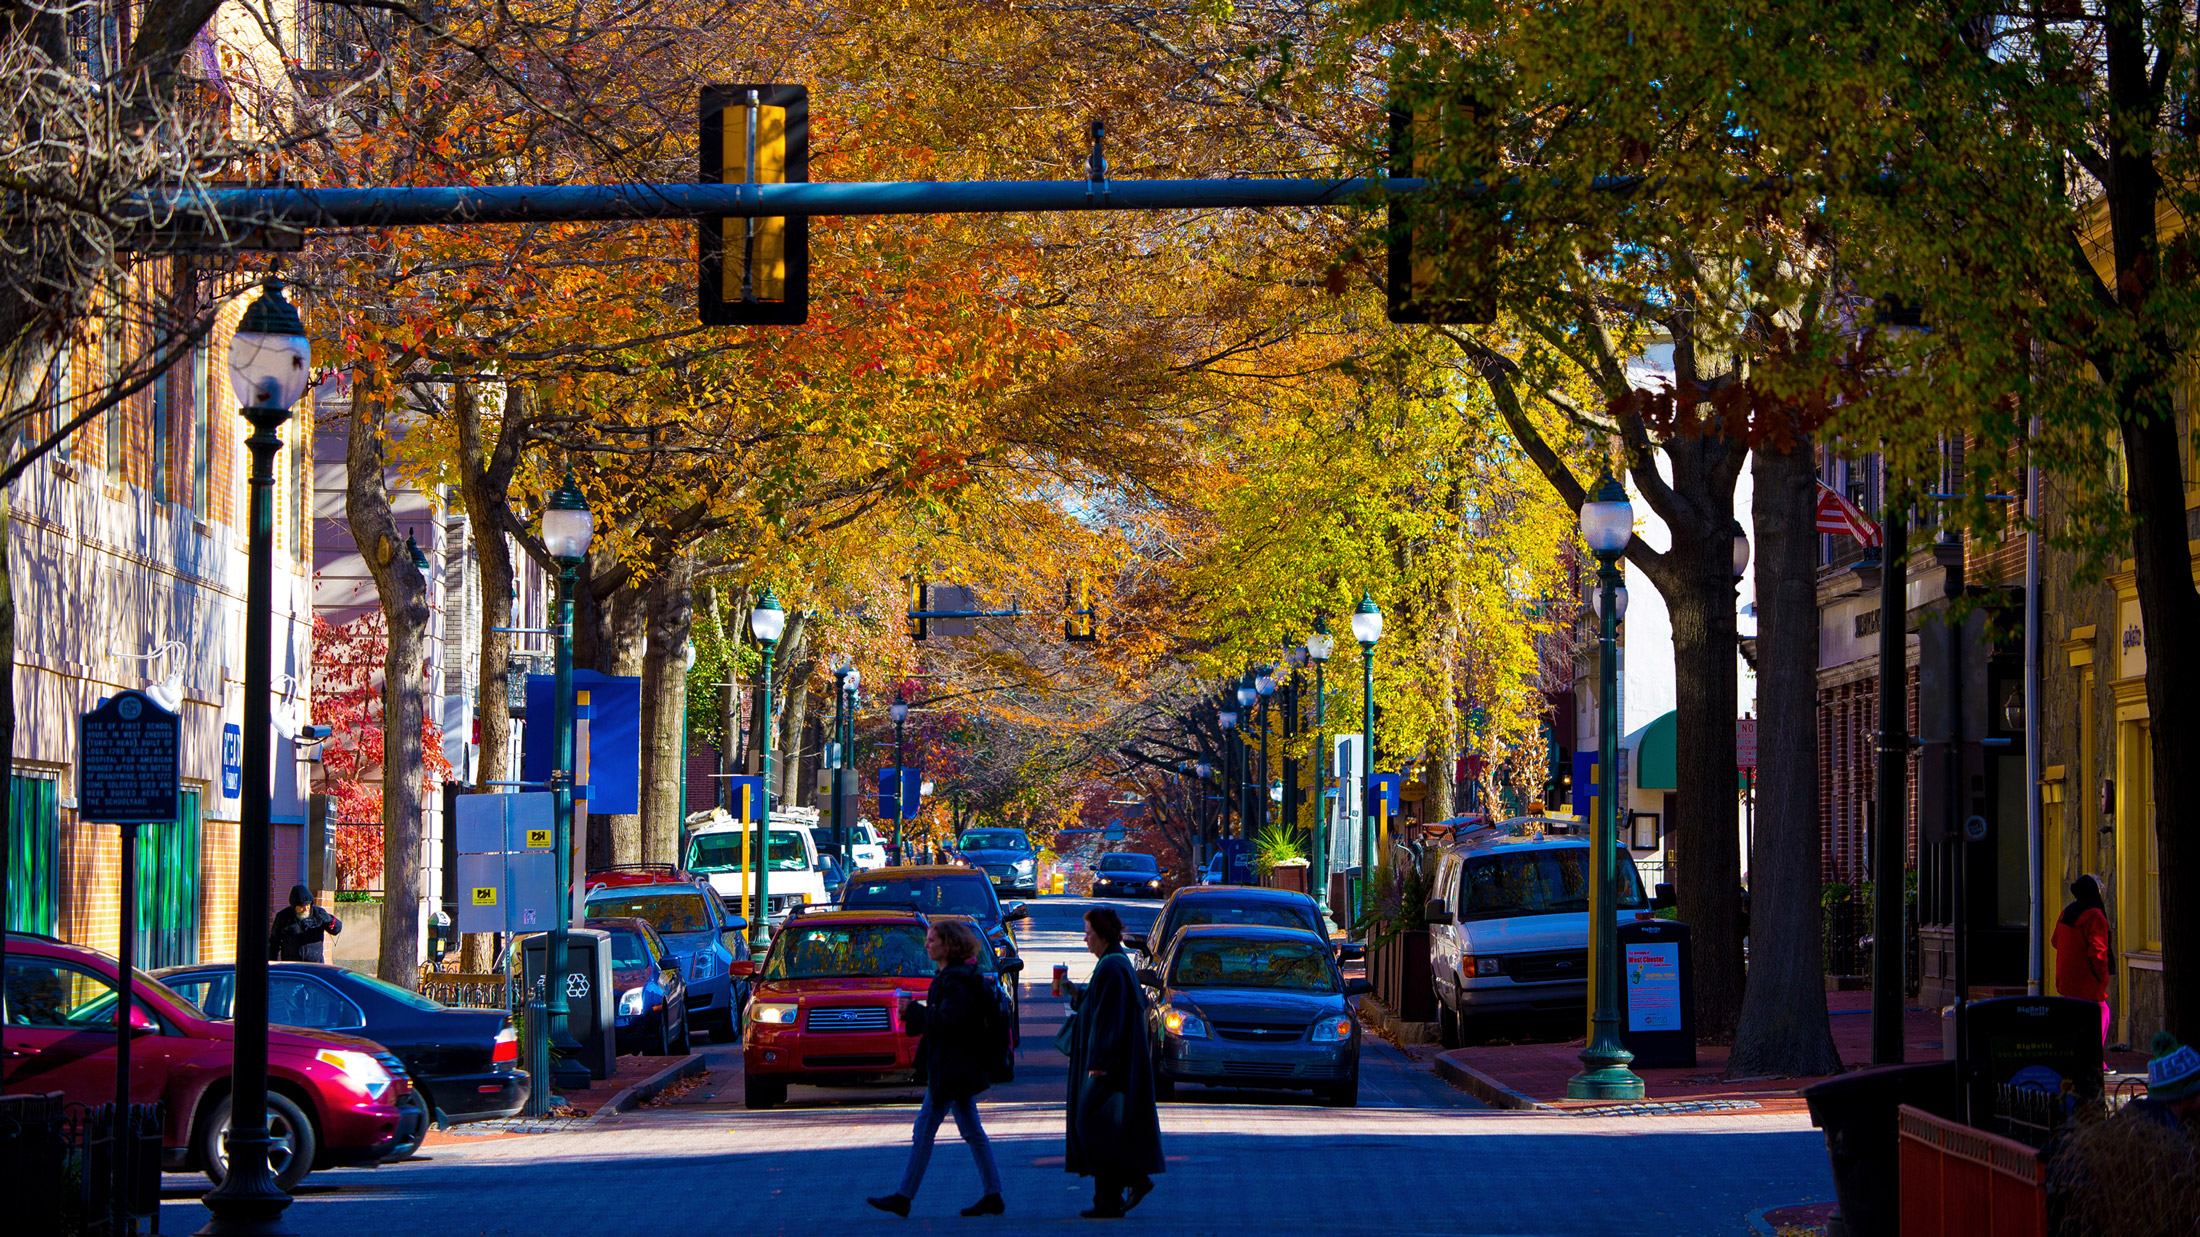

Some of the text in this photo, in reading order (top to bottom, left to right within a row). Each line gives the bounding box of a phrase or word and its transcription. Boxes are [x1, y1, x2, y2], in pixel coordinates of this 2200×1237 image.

[86, 722, 173, 730] SITE OF FIRST SCHOOL
[1742, 724, 1753, 732] NO
[141, 739, 160, 747] BUILT
[164, 739, 173, 747] OF
[115, 764, 135, 772] AFTER
[136, 764, 148, 772] THE
[150, 764, 172, 772] BATTLE
[86, 773, 95, 781] OF
[86, 781, 173, 789] SOME SOLDIERS DIED AND
[86, 789, 173, 797] WERE BURIED HERE IN
[86, 798, 100, 806] THE
